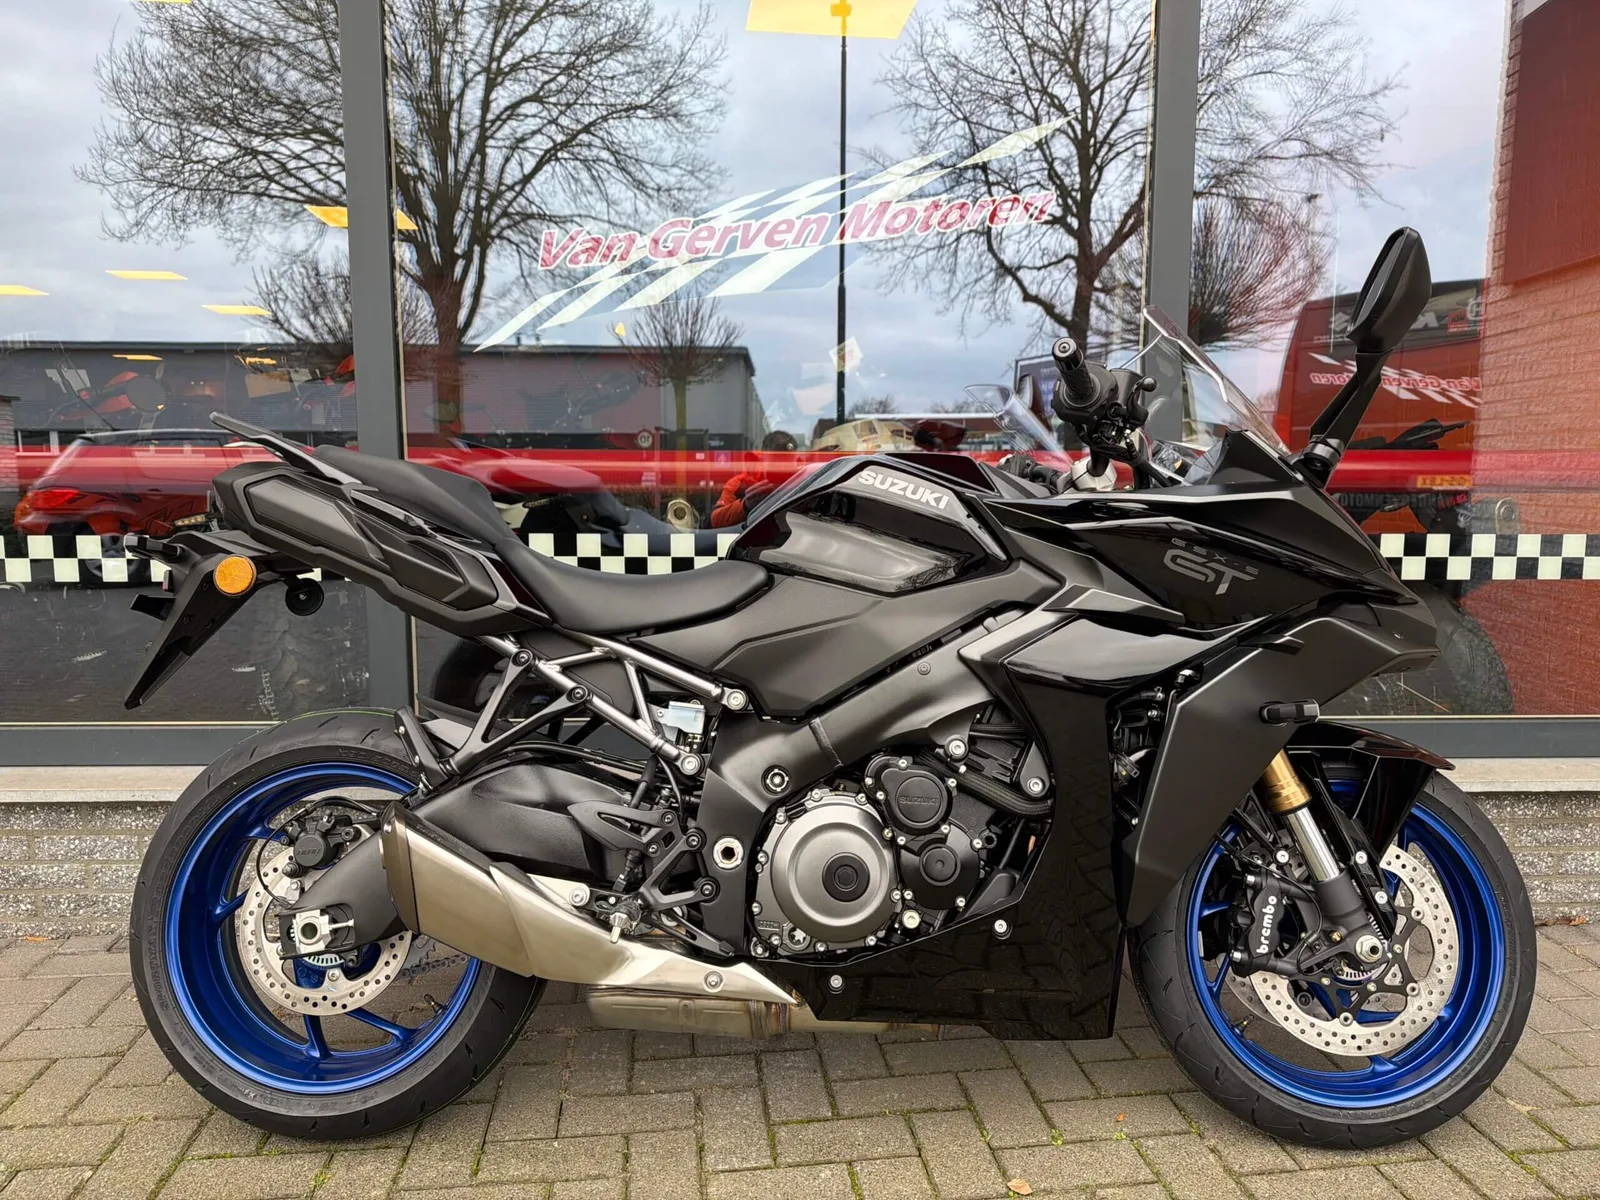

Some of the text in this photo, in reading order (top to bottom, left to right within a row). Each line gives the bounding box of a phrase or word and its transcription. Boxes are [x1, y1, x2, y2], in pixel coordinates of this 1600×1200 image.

[538, 190, 1056, 270] Van Gerven Motoren
[858, 468, 950, 510] SUZUKI
[1171, 537, 1259, 575] GSX-S
[899, 795, 939, 806] SUZUKI
[1256, 895, 1277, 954] brembo
